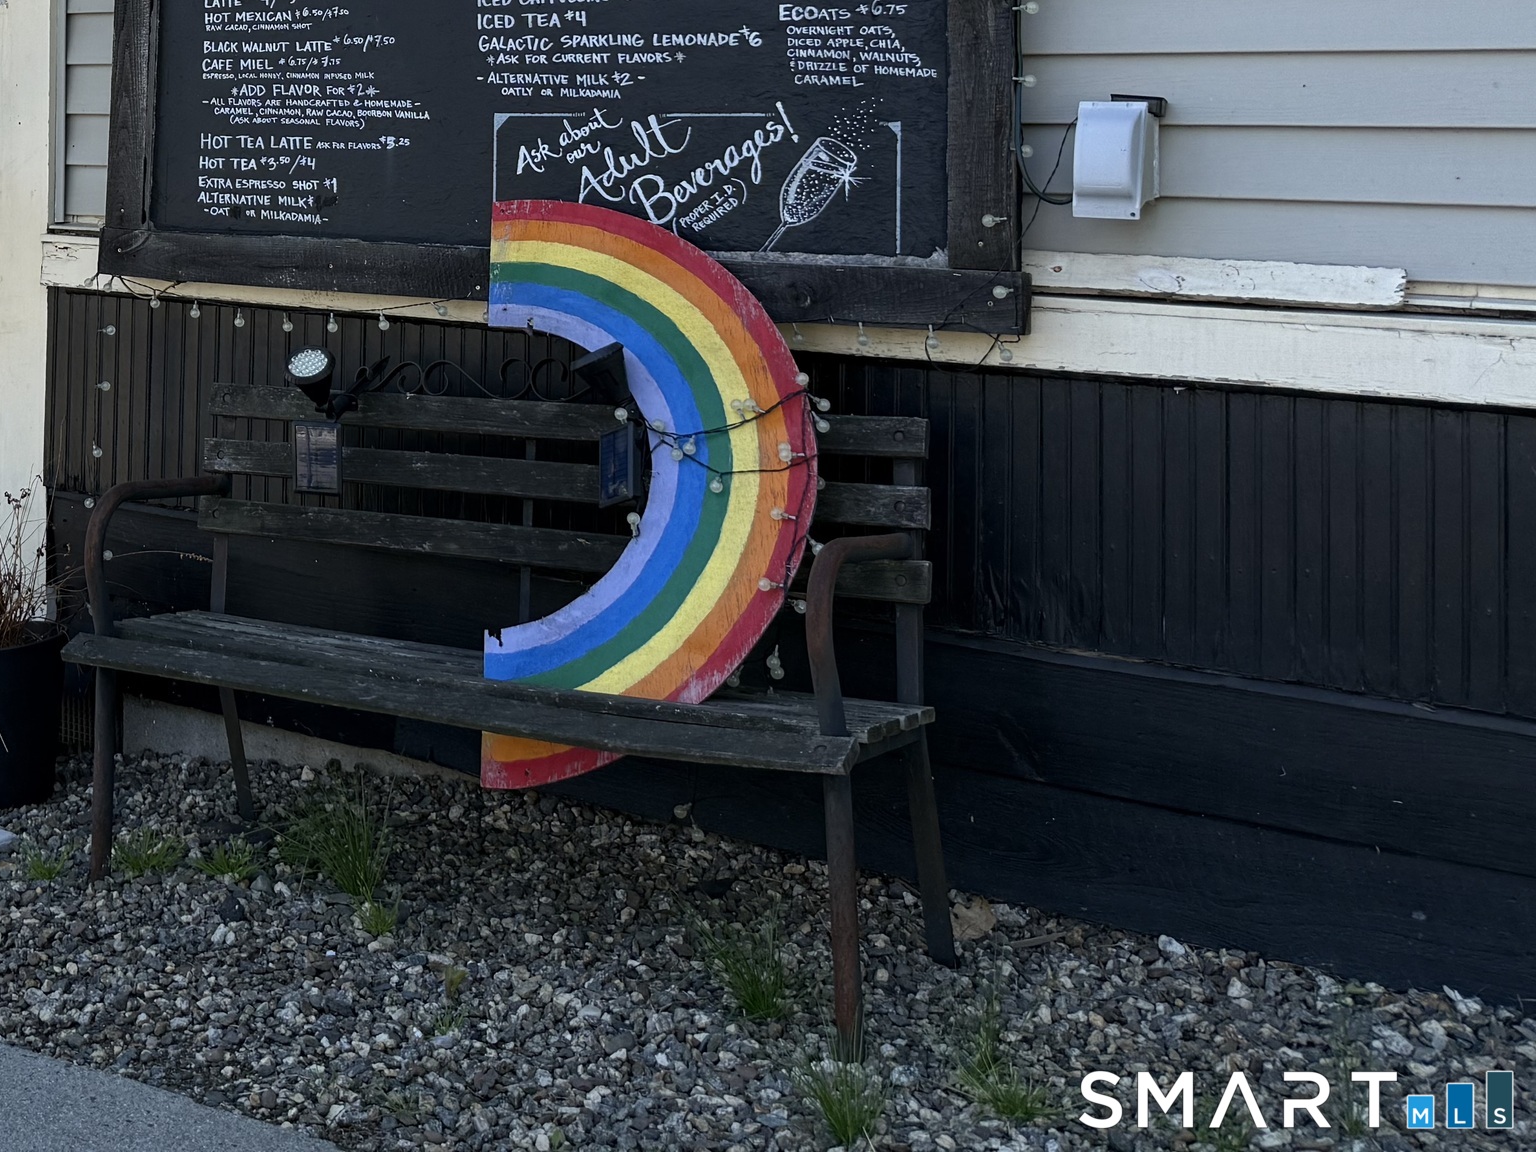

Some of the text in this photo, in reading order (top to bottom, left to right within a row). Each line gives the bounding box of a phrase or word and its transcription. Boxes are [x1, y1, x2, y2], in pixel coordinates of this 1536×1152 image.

[855, 0, 907, 17] $6.75
[205, 11, 292, 24] HOT MEXICAN
[477, 14, 515, 30] ICED
[522, 13, 560, 28] TEA
[787, 26, 895, 38] OVERNIGHT OATS,
[203, 41, 331, 53] BLACK WALNUT LATTE
[479, 33, 739, 52] GALACTIC SPARKLING LEMONADE
[788, 38, 905, 52] DICED APPLE, CHIA,
[202, 59, 273, 71] CAFE MIEL
[787, 49, 921, 67] CINNAMON, WALNUTS,
[798, 61, 937, 78] DRIZZLE OF HOMEMADE
[488, 72, 568, 85] ALTERNATIVE
[577, 74, 608, 86] MILK
[794, 75, 864, 87] CARAMEL
[502, 87, 621, 99] OATLY OR MILKADAMIA
[228, 98, 262, 107] FLAVORS
[265, 99, 281, 107] ARE
[286, 99, 350, 107] HANDCRAFTED
[357, 110, 392, 118] BOURBON
[395, 110, 429, 119] VANILLA
[200, 133, 232, 149] HOT
[236, 135, 264, 149] TEA
[271, 136, 312, 149] LATTE
[316, 140, 330, 149] ASK
[348, 141, 381, 149] FLAVORS
[516, 109, 623, 175] Ask about
[566, 140, 601, 164] our
[579, 115, 691, 203] Adult
[629, 101, 799, 225] Beverages!
[198, 176, 232, 188] EXTRA
[236, 179, 286, 189] ESPRESSO
[293, 181, 319, 190] SHOT
